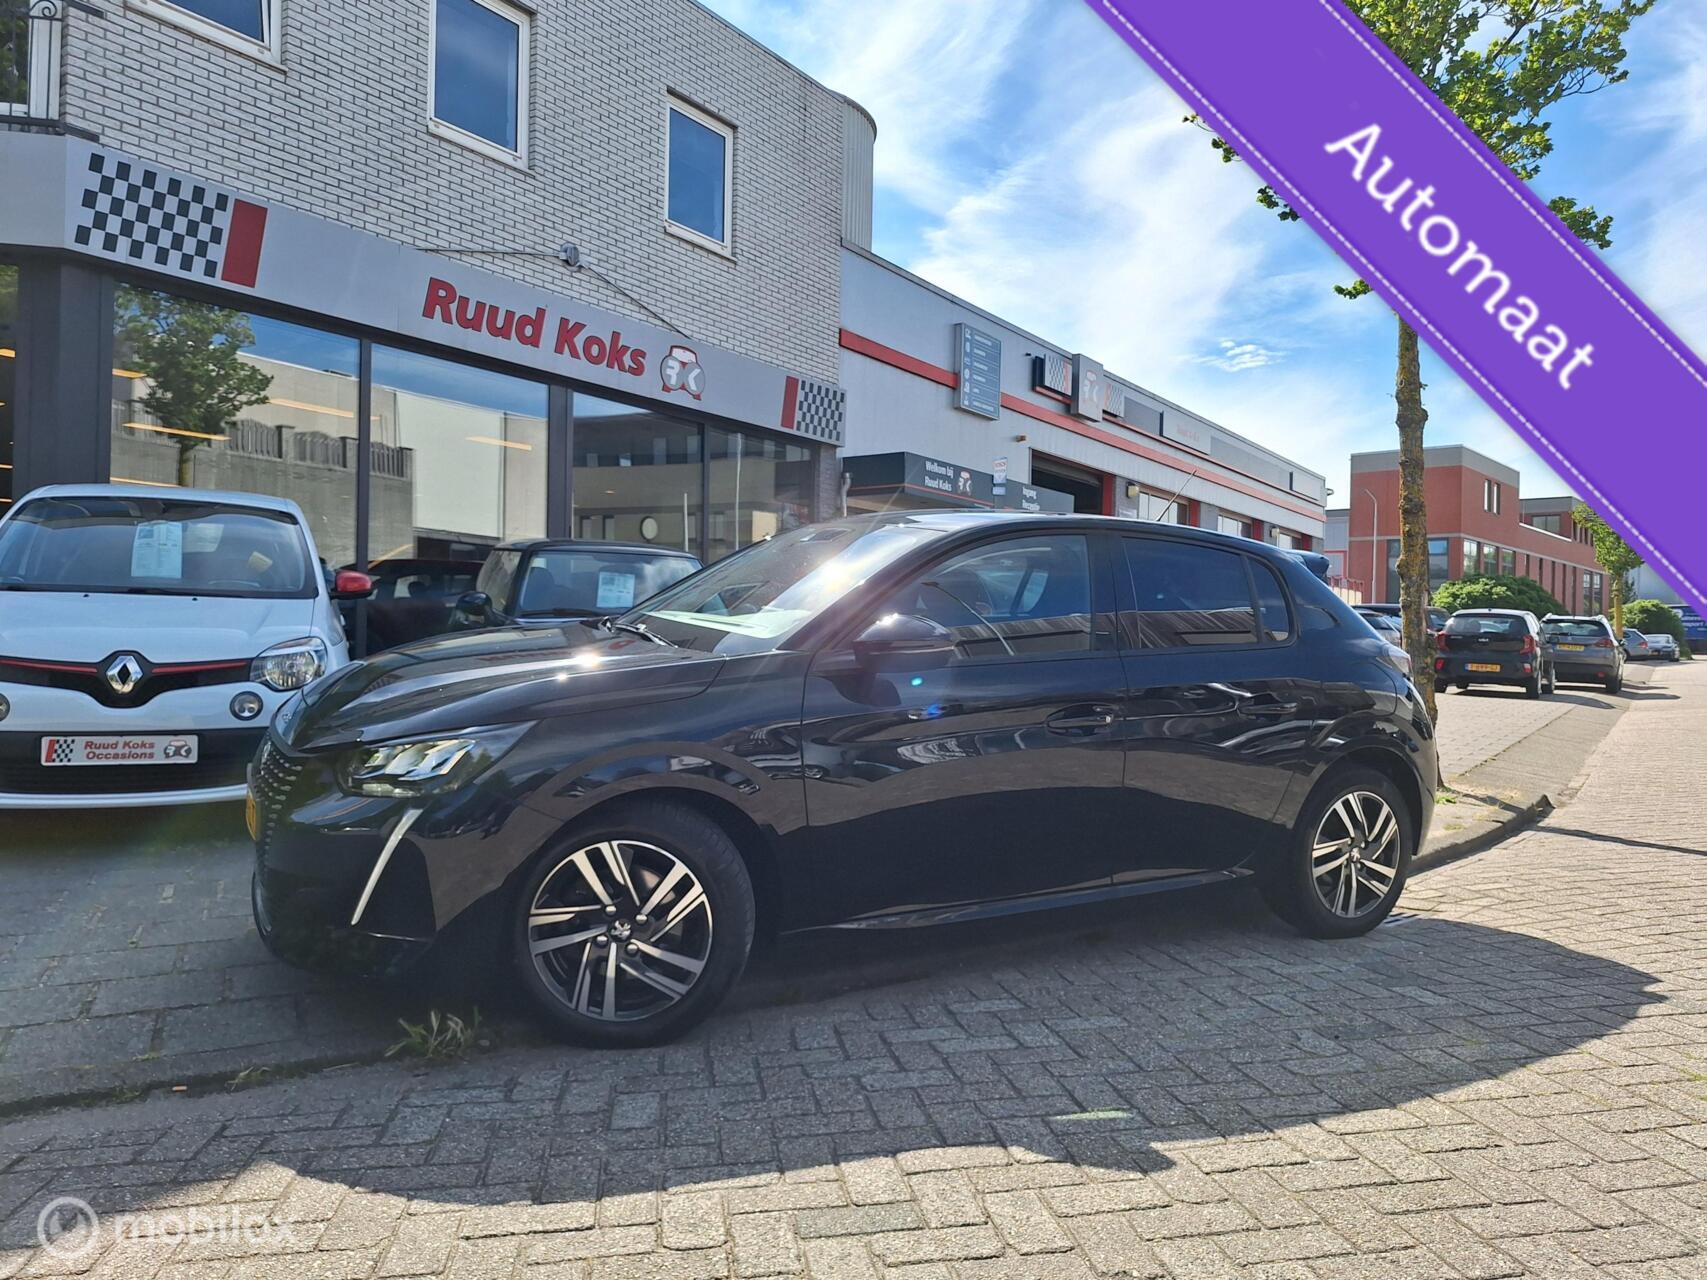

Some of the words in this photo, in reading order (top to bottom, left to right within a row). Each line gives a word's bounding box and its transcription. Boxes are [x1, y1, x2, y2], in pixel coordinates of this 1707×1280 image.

[422, 277, 546, 348] Ruud
[554, 317, 647, 377] Koks
[925, 461, 947, 475] Welkom
[925, 476, 939, 490] Ruud
[939, 479, 953, 492] Koks
[84, 740, 118, 750] Ruud
[122, 740, 155, 749] Koks
[86, 750, 155, 760] Occasions
